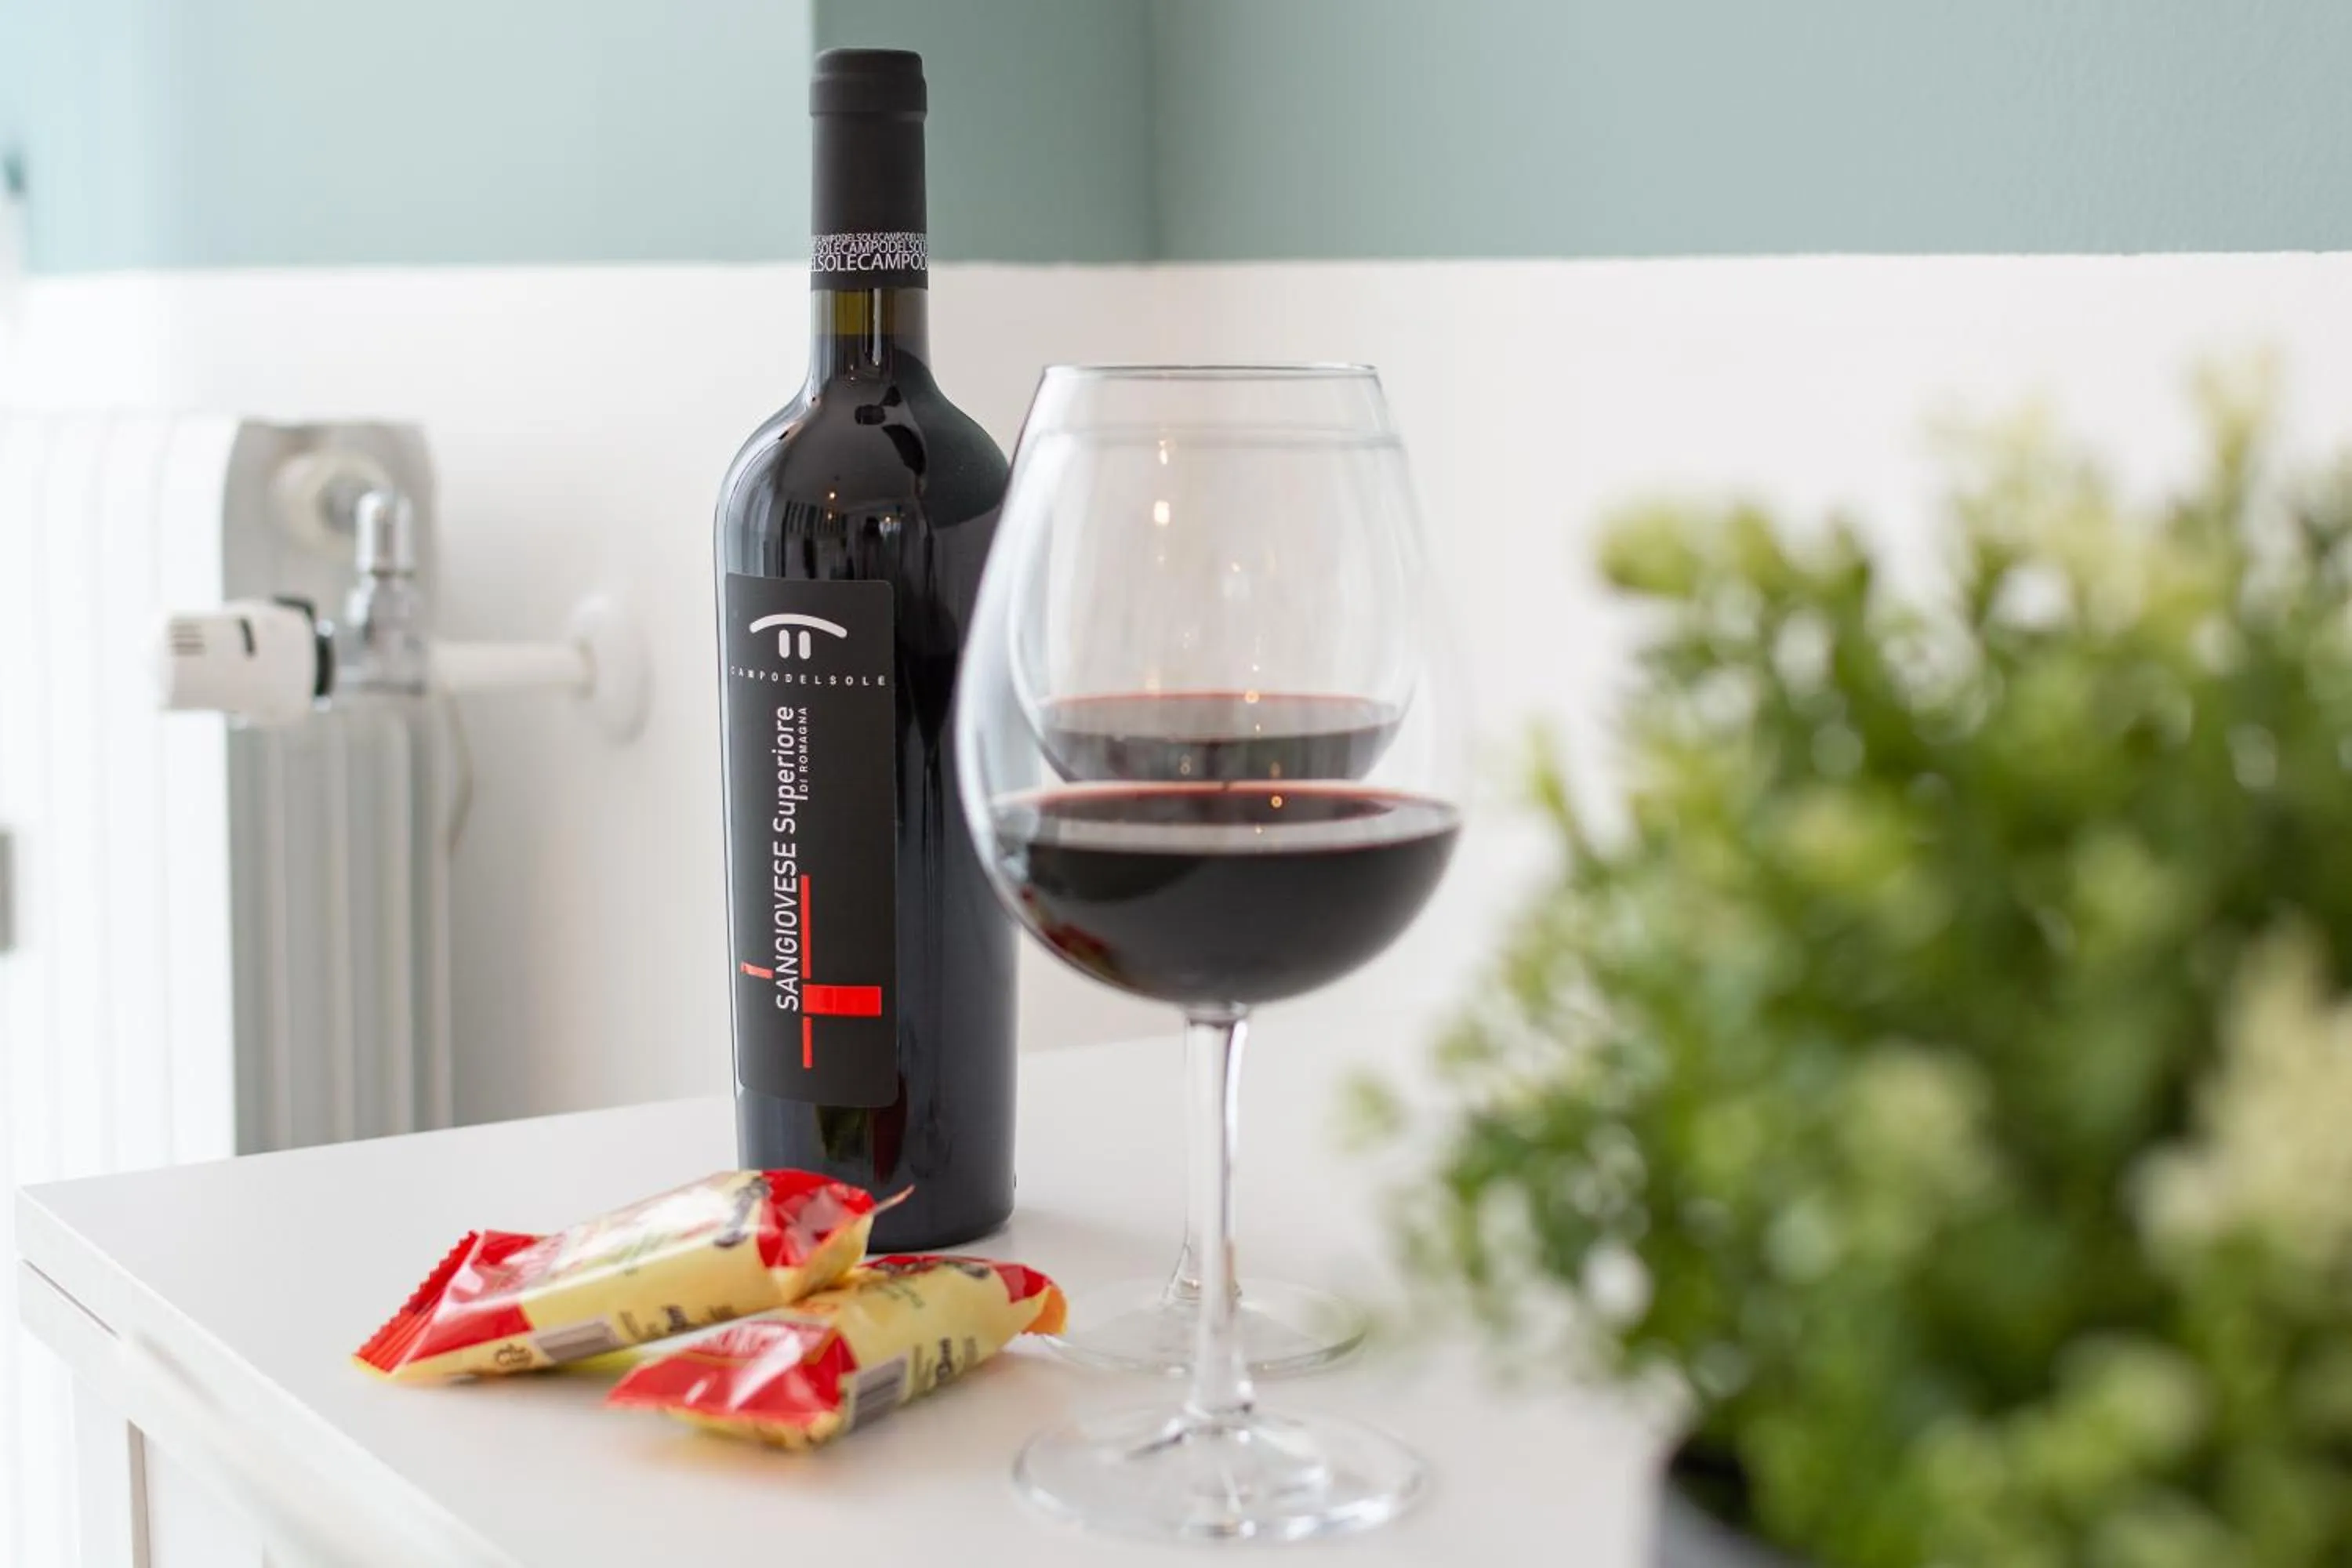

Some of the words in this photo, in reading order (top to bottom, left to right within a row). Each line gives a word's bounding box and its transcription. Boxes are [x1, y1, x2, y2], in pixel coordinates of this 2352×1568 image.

[730, 666, 886, 687] CAMPODELSOLE
[771, 706, 808, 834] Superiore
[798, 707, 808, 772] ROMAGNA
[799, 779, 808, 793] DI
[773, 840, 798, 1012] SANGIOVESE
